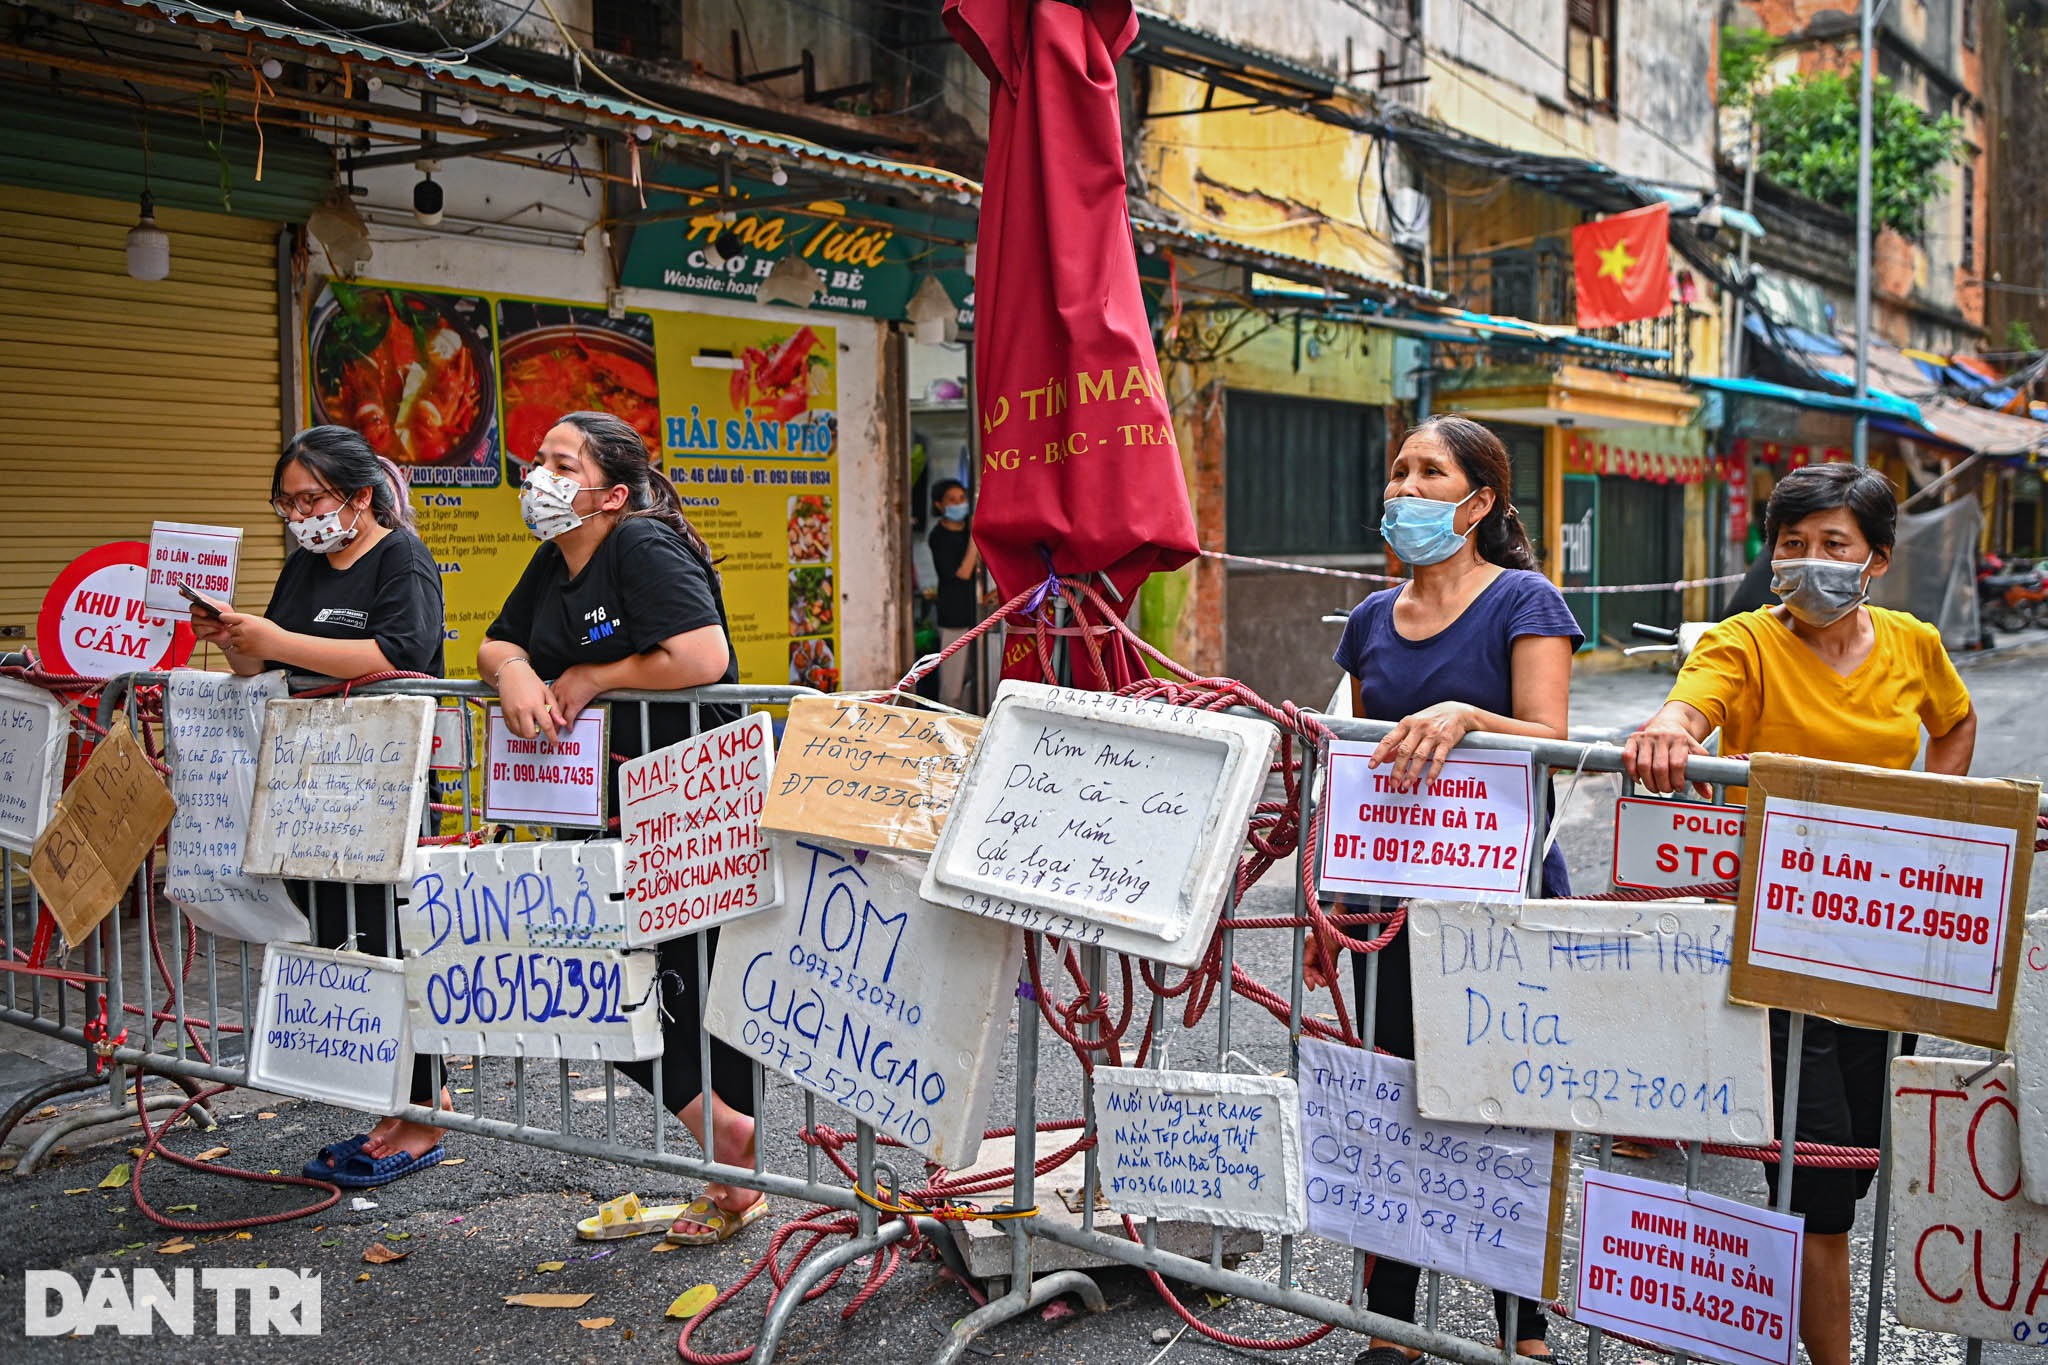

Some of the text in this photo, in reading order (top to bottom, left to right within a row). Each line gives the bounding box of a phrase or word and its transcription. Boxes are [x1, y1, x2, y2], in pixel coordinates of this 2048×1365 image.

[664, 268, 726, 292] Website:
[667, 405, 719, 449] HẢI
[726, 408, 779, 451] SẢN
[436, 469, 455, 483] POT
[457, 469, 496, 484] SHRIMP
[691, 468, 704, 483] 46
[421, 493, 462, 507] TÔM
[454, 509, 479, 520] Shrimp
[682, 496, 720, 506] NGAO
[171, 548, 189, 563] LÂN
[197, 551, 228, 567] CHỈNH
[473, 545, 497, 556] Shrimp
[74, 590, 120, 618] KHU
[74, 624, 151, 659] CẤM
[557, 741, 580, 756] KHO
[717, 723, 764, 763] KHO
[493, 763, 594, 786] ĐT: 090.449.7435
[684, 766, 716, 801] CÁ
[1428, 776, 1488, 800] NGHĨA
[1359, 802, 1498, 831] CHUYÊN GÀ TA
[640, 844, 684, 874] TÔM
[1333, 833, 1518, 870] ĐT: 0912.643.712
[1656, 843, 1741, 880] STO
[1781, 846, 1984, 899] BÒ LÂN CHỈNH
[412, 871, 511, 956] BÚN
[638, 883, 759, 933] 0396011443
[796, 840, 908, 984] TÔM
[1767, 882, 1990, 946] ĐT: 093.612.9598
[277, 956, 318, 987] HOA
[427, 953, 629, 1025] 0965152391
[789, 944, 922, 1026] 0972520710
[742, 1019, 932, 1146] 0972520710
[1313, 1068, 1367, 1098] THỊT
[1512, 1060, 1729, 1115] 0979278011
[1217, 1102, 1263, 1122] RANG
[1631, 1210, 1749, 1258] MINH HẠNH
[1602, 1235, 1775, 1298] CHUYÊN HẢI SẢN
[1589, 1263, 1784, 1341] ĐT: 0915.432.675
